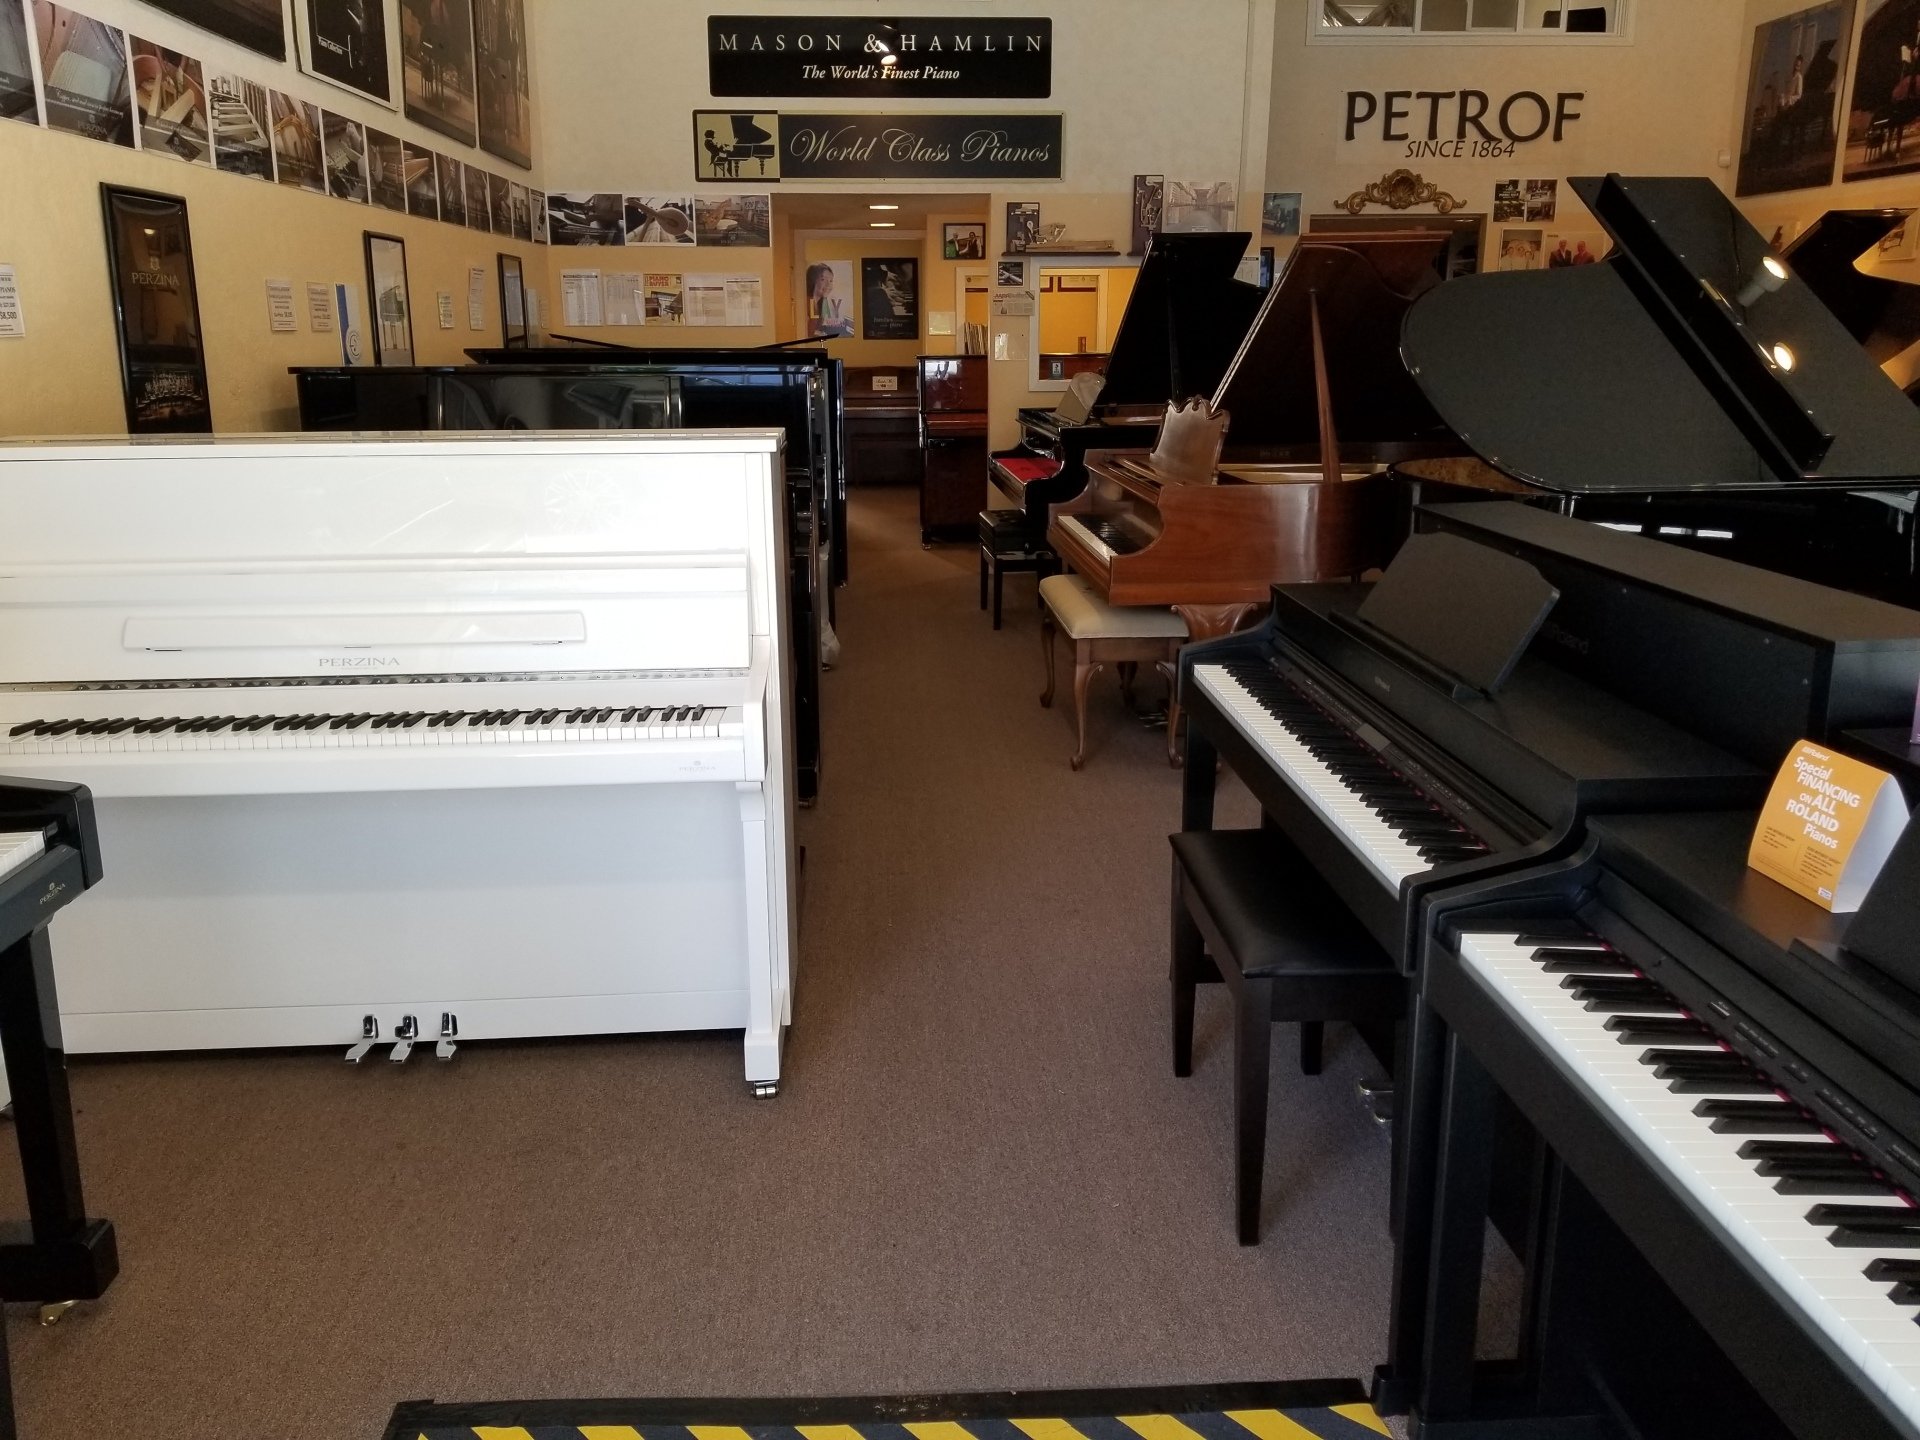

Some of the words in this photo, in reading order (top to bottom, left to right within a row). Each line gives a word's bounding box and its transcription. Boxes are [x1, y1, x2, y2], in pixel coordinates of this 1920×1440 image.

[719, 33, 843, 52] MASON
[864, 34, 890, 53] &
[900, 34, 1042, 53] HAMLIN
[802, 65, 826, 80] The
[830, 65, 879, 81] World's
[881, 65, 920, 81] Finest
[923, 65, 960, 81] Piano
[1345, 89, 1585, 143] PETROF
[790, 125, 877, 163] World
[881, 127, 952, 163] Class
[960, 128, 1051, 164] Pianos
[1405, 140, 1466, 159] SINCE
[1471, 140, 1516, 159] 1864
[131, 272, 180, 287] PERZINA
[319, 657, 400, 667] PERZINA
[1793, 756, 1833, 780] Special
[1796, 770, 1861, 808] FINANCING
[1799, 792, 1812, 804] ON
[1811, 794, 1836, 815] ALL
[1785, 799, 1839, 832] ROLAND
[1803, 822, 1839, 849] Pianos
